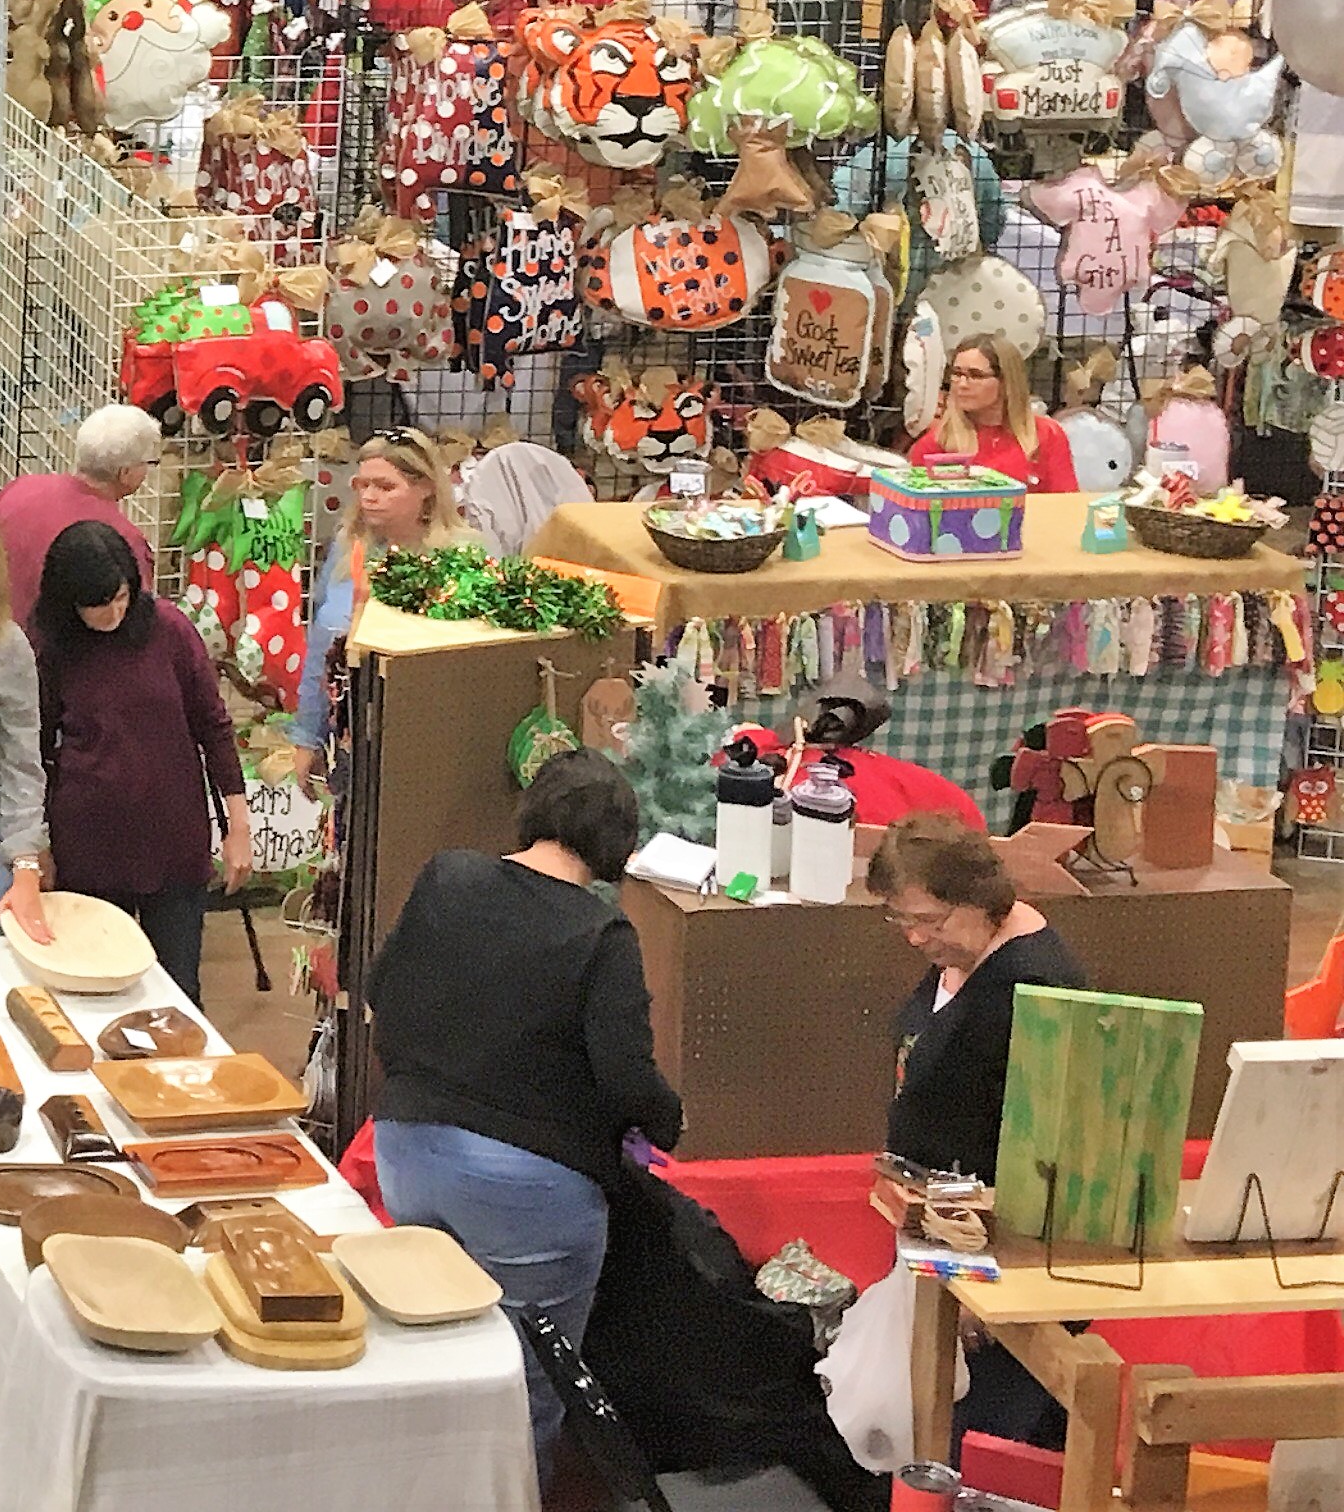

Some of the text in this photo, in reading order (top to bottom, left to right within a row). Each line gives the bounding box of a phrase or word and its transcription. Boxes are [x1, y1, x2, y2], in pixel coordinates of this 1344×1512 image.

[1038, 58, 1083, 84] Just
[1022, 82, 1103, 116] Married
[1074, 188, 1114, 223] It's
[501, 221, 575, 276] Home
[1105, 218, 1123, 252] A
[246, 784, 293, 816] erry
[210, 817, 324, 870] stmas
